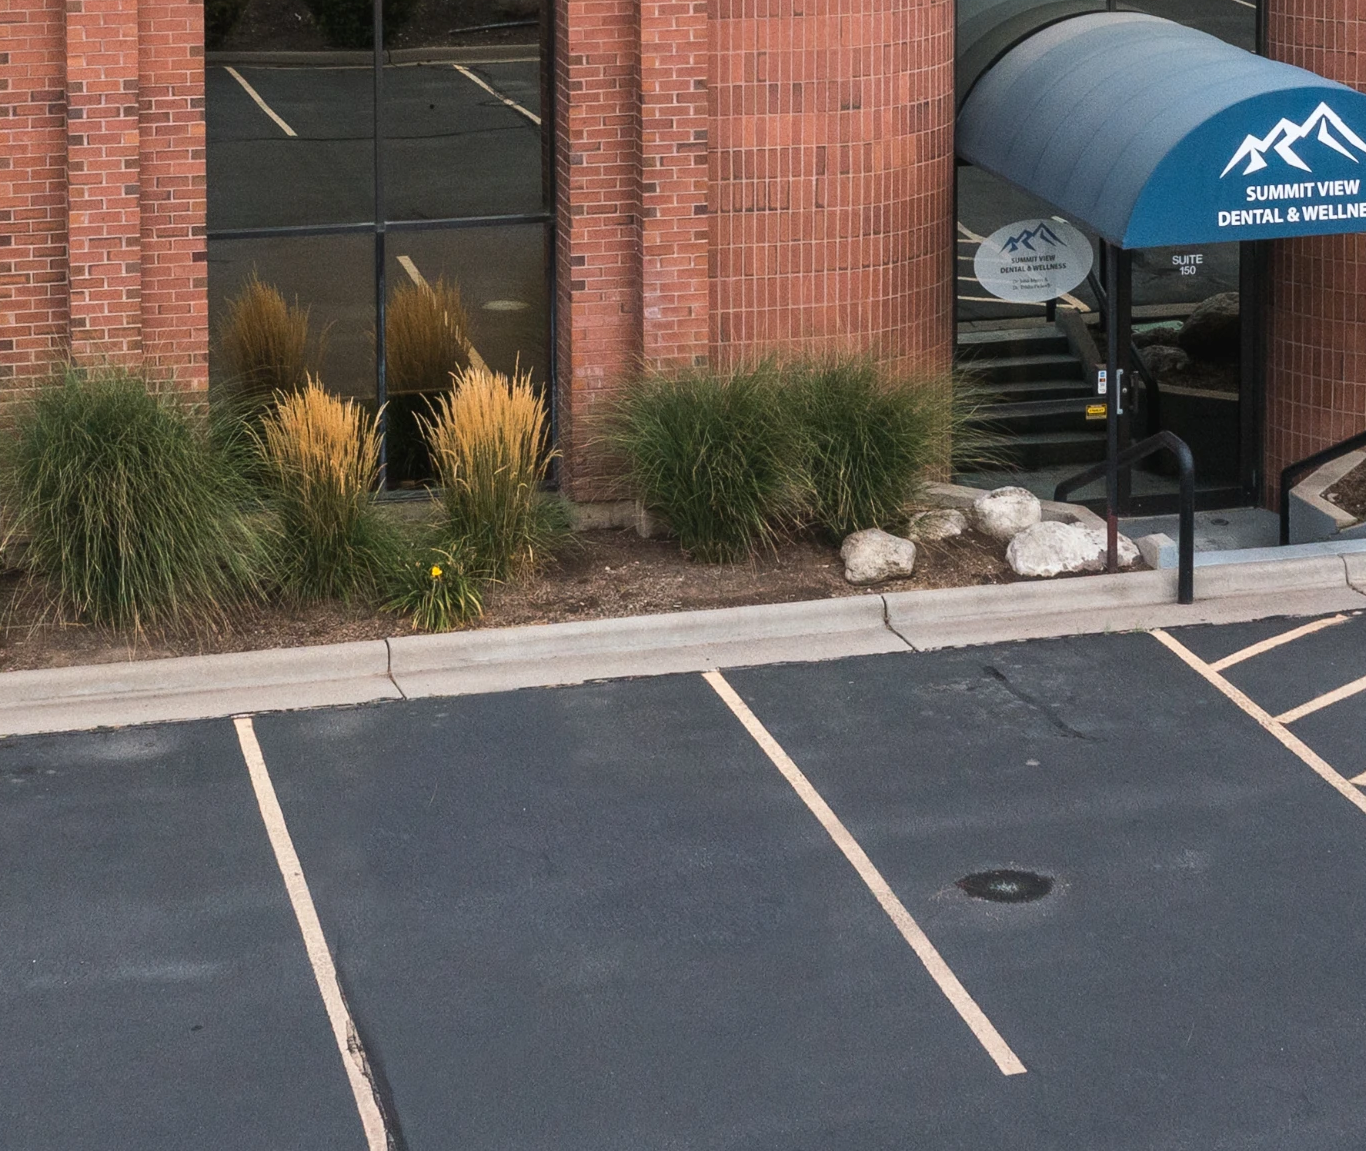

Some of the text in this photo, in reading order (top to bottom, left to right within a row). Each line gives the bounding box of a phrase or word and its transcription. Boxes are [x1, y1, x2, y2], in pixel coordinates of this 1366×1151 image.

[1246, 179, 1360, 201] SUMMIT VIEW
[1218, 208, 1284, 226] DENTAL
[1287, 207, 1300, 222] &
[1172, 254, 1203, 265] SUITE
[1033, 263, 1067, 271] WELLNESS
[1179, 265, 1196, 275] 150
